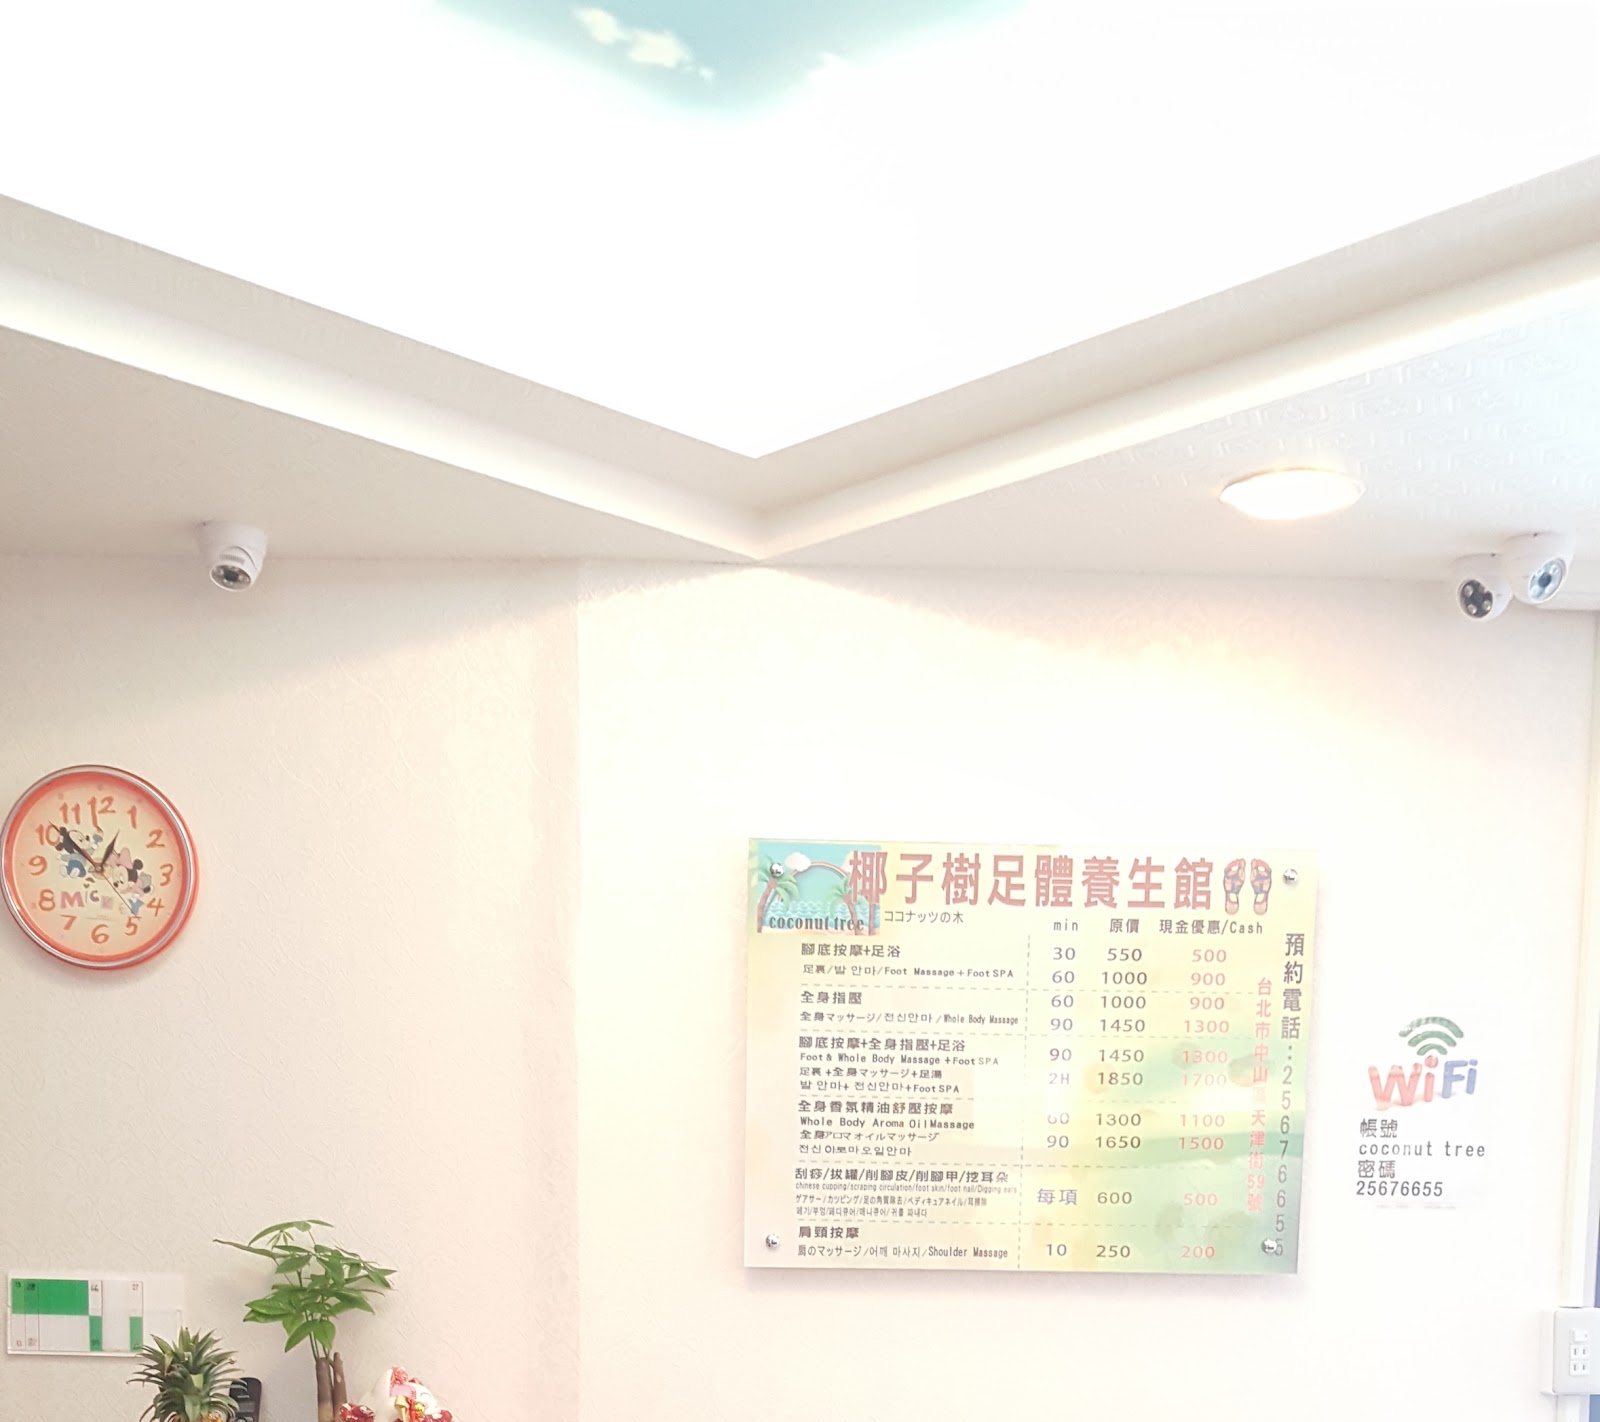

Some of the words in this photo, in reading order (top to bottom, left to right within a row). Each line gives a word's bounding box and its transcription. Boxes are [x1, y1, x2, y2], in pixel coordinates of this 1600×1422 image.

[59, 802, 81, 824] 11
[87, 796, 116, 831] 12
[126, 805, 137, 829] 1
[146, 829, 165, 848] 2
[28, 855, 47, 875] 9
[159, 863, 173, 886] 3
[849, 850, 1214, 910] 椰子樹足體養生館
[38, 889, 56, 911] 8
[146, 897, 164, 916] 4
[61, 914, 76, 930] 7
[769, 916, 830, 930] coconut
[834, 916, 865, 931] tree
[884, 911, 964, 924] ココナッツの木
[125, 916, 141, 935] 5
[1053, 919, 1079, 931] min
[1110, 919, 1140, 934] 原價
[1159, 920, 1263, 934] 現金優惠/Cash
[91, 924, 109, 943] 6
[801, 943, 901, 958] 腳底按摩+足浴
[1052, 947, 1076, 961] 30
[1106, 948, 1143, 962] 550
[1192, 949, 1227, 963] 500
[1051, 970, 1075, 984] 60
[1102, 971, 1147, 985] 1000
[1190, 972, 1226, 986] 900
[801, 991, 862, 1005] 全身指壓
[1051, 995, 1074, 1009] 60
[1101, 996, 1146, 1009] 1000
[1190, 997, 1225, 1010] 900
[968, 1014, 985, 1026] Body
[990, 1014, 1019, 1025] Massage
[1050, 1018, 1073, 1032] 90
[1100, 1019, 1145, 1033] 1450
[1184, 1020, 1230, 1033] 1300
[838, 1053, 866, 1063] Whole
[872, 1053, 895, 1065] Body
[901, 1055, 940, 1065] Massage
[1049, 1048, 1072, 1062] 90
[1099, 1049, 1144, 1063] 1450
[1182, 1050, 1228, 1064] 1300
[1049, 1072, 1070, 1085] 2H
[1098, 1072, 1143, 1086] 1850
[1182, 1073, 1227, 1087] 1700
[800, 1117, 832, 1127] Whole
[840, 1117, 865, 1128] Body
[872, 1118, 904, 1128] Aroma
[1096, 1113, 1142, 1127] 1300
[1180, 1114, 1225, 1128] 1100
[1360, 1118, 1398, 1138] 帳號
[1047, 1135, 1069, 1148] 90
[1096, 1136, 1141, 1149] 1650
[1179, 1137, 1224, 1151] 1500
[1359, 1141, 1432, 1156] coconut
[1445, 1141, 1485, 1157] tree
[1358, 1160, 1396, 1179] 密碼
[1356, 1181, 1443, 1197] 25676655
[1037, 1189, 1077, 1205] 每項
[1097, 1192, 1132, 1205] 600
[1184, 1193, 1218, 1206] 500
[799, 1226, 859, 1239] 肩頸按摩
[973, 1247, 1008, 1259] Massage
[1046, 1244, 1067, 1257] 10
[1096, 1244, 1131, 1258] 250
[1181, 1245, 1215, 1259] 200
